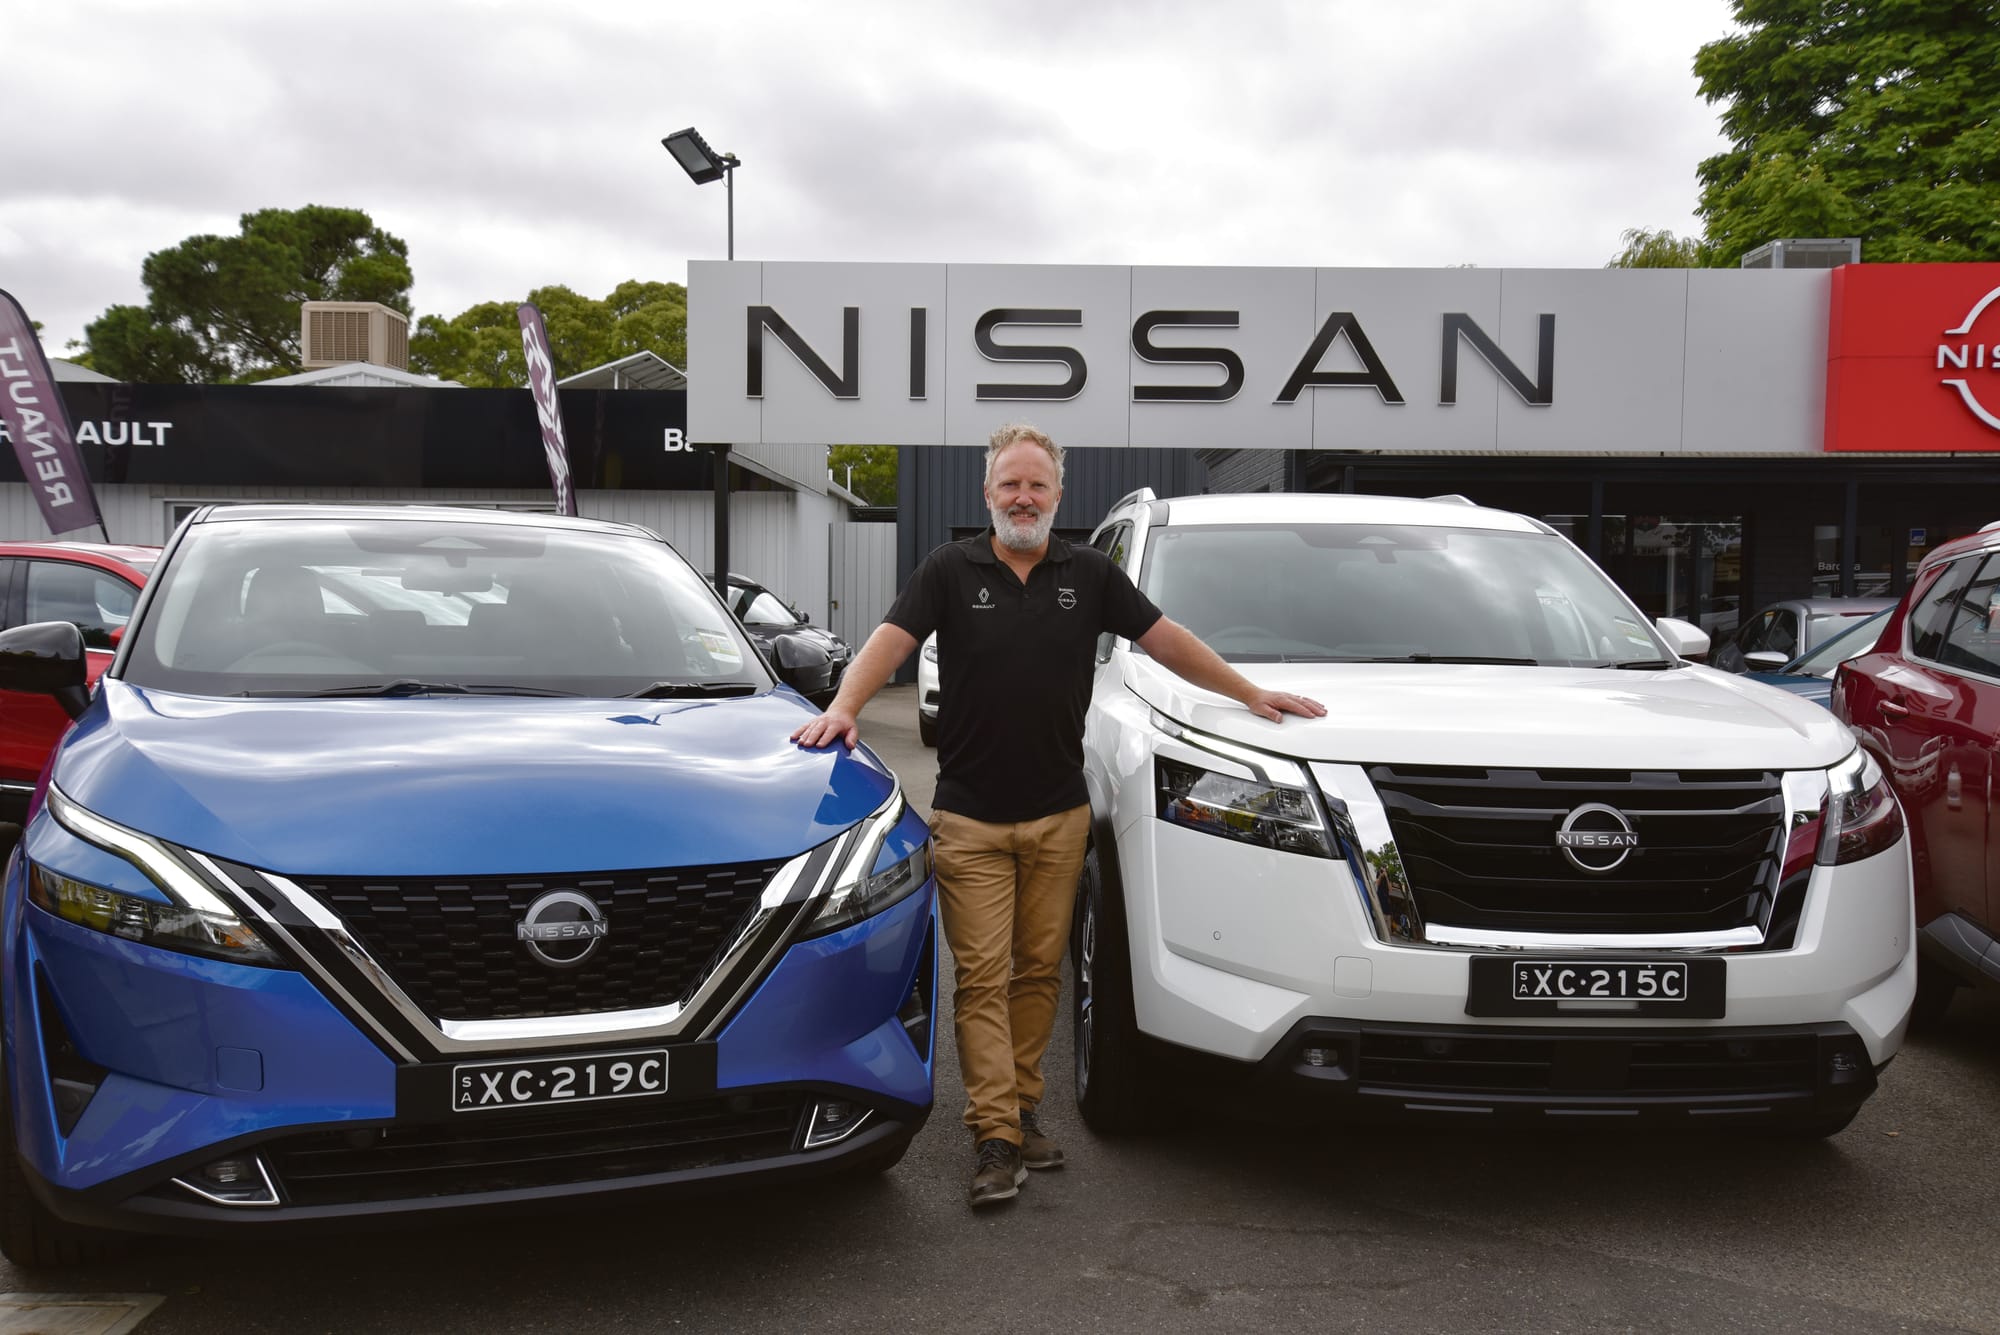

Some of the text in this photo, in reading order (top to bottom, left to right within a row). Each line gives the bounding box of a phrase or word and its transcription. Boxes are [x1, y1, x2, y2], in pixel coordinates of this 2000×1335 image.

[746, 305, 1556, 405] NISSAN
[1558, 835, 1637, 846] NISSAN
[520, 923, 607, 938] NISSAN
